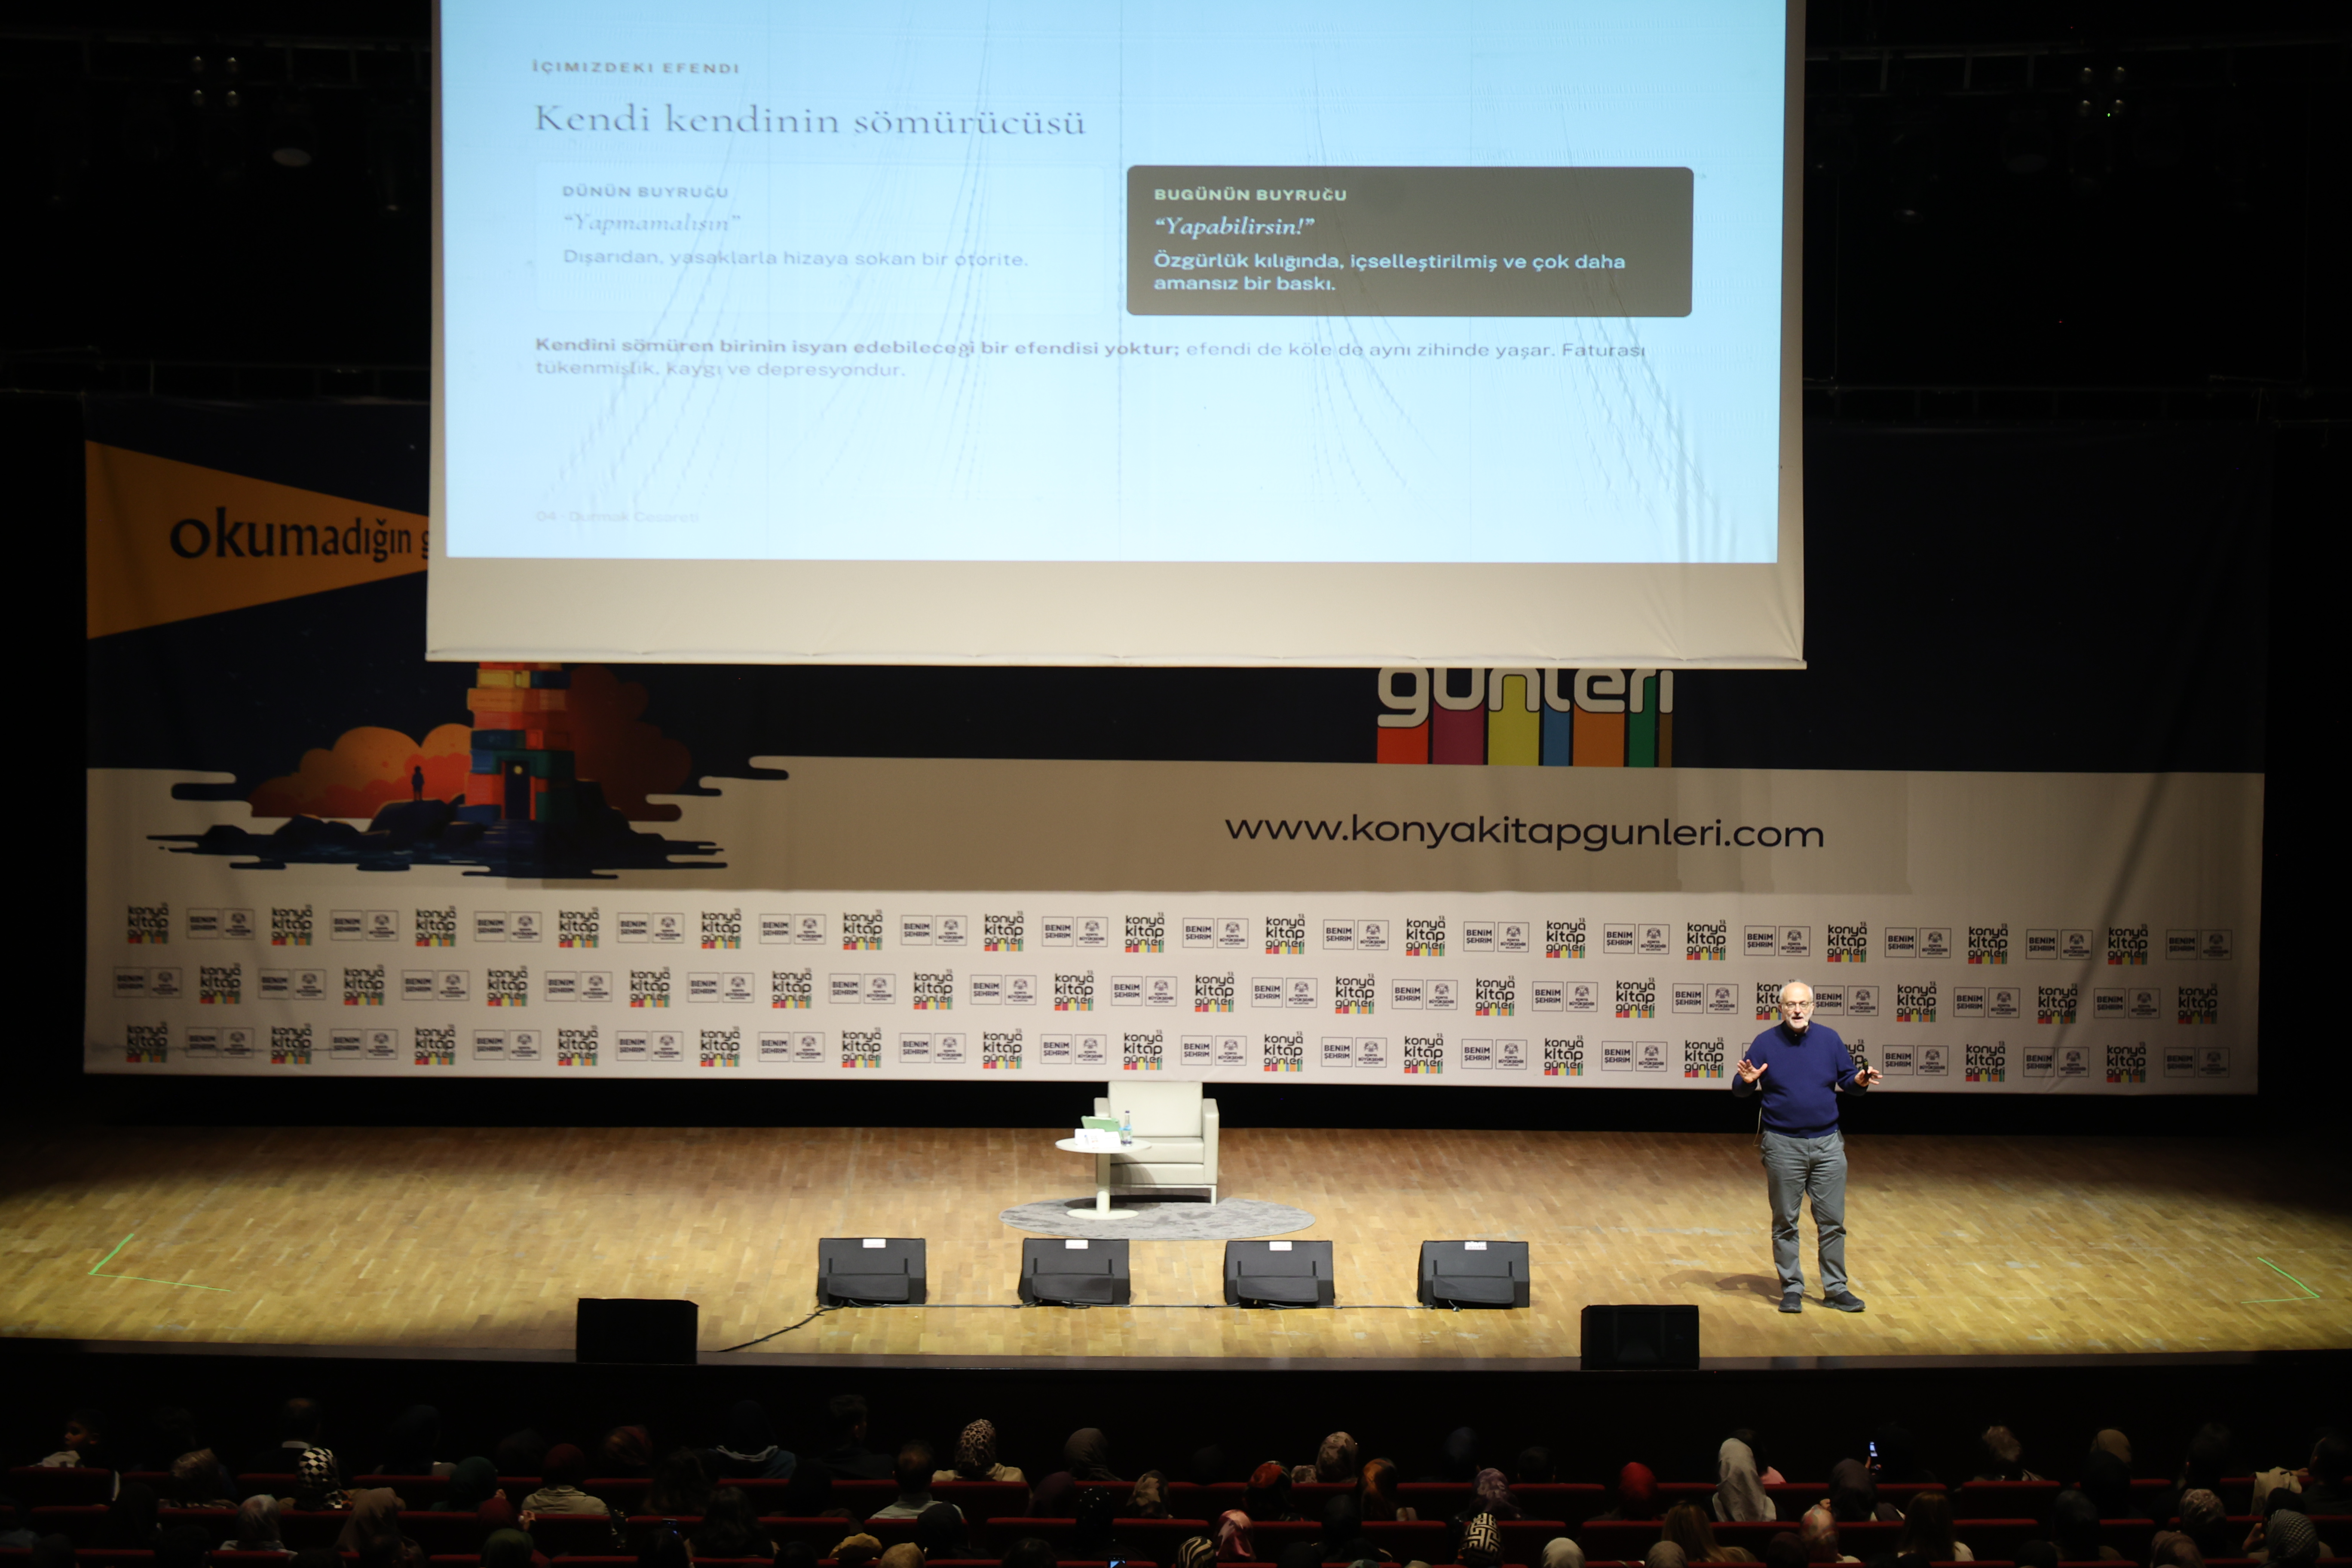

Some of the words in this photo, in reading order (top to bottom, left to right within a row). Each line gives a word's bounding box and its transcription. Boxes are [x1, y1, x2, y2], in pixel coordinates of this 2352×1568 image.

[534, 102, 649, 132] Kendi
[664, 103, 841, 134] kendinin
[854, 110, 1086, 135] sömürücüsü
[563, 184, 631, 197] DÜNÜN
[638, 185, 729, 198] BUYRUĞU
[1154, 187, 1250, 201] BUGÜNÜN
[1256, 187, 1347, 201] BUYRUĞU
[564, 249, 665, 266] Dışarıdan,
[670, 250, 778, 266] yasaklarla
[784, 251, 848, 267] hizaya
[855, 252, 915, 266] sokan
[923, 252, 948, 266] bir
[955, 253, 1028, 266] otorite.
[1153, 249, 1249, 270] Özgürlük
[1254, 253, 1344, 272] kılığında,
[1351, 254, 1498, 272] içselleştirilmiş
[1503, 257, 1527, 269] ve
[1532, 254, 1570, 272] çok
[1574, 255, 1626, 269] daha
[1154, 278, 1238, 290] amansız
[1244, 276, 1271, 290] bir
[1276, 276, 1336, 291] baskı.
[536, 338, 616, 352] Kendini
[622, 339, 714, 353] sömüren
[720, 339, 786, 353] birinin
[793, 340, 846, 355] isyan
[854, 340, 974, 358] edebileceği
[982, 341, 1008, 354] bir
[1015, 341, 1098, 355] efendisi
[1104, 342, 1179, 357] yoktur;
[1187, 342, 1251, 356] efendi
[1258, 343, 1282, 356] de
[1289, 343, 1332, 356] köle
[1339, 343, 1363, 356] de
[1370, 345, 1411, 359] aynı
[1417, 343, 1489, 357] zihinde
[1496, 346, 1556, 359] yaşar.
[1562, 343, 1645, 356] Faturası
[536, 361, 659, 378] tükenmişlik,
[667, 362, 721, 378] kaygı
[729, 364, 750, 376] ve
[757, 363, 905, 378] depresyondur.
[170, 506, 412, 563] okumadığın
[1224, 814, 1824, 852] www.konyakitapgunleri.com
[985, 913, 1024, 926] konya
[1126, 914, 1165, 927] konya
[1266, 916, 1305, 928] konya
[1406, 918, 1446, 931] konya
[1547, 920, 1586, 933] konya
[985, 923, 1023, 938] kitap
[1126, 925, 1164, 939] kitap
[1266, 926, 1305, 940] kitap
[1687, 922, 1726, 934] konya
[1828, 924, 1867, 937] konya
[1969, 925, 2008, 938] konya
[1406, 928, 1445, 943] kitap
[1547, 930, 1585, 945] kitap
[1687, 932, 1726, 946] kitap
[1828, 934, 1866, 949] kitap
[1969, 936, 2007, 950] kitap
[1055, 972, 1094, 985] konya
[1335, 975, 1375, 988] konya
[1476, 977, 1515, 990] konya
[1055, 983, 1093, 997] kitap
[1335, 986, 1374, 1000] kitap
[1616, 980, 1655, 992] konya
[1897, 983, 1936, 996] konya
[2178, 986, 2217, 998] konya
[1476, 988, 1515, 1002] kitap
[1616, 990, 1655, 1004] kitap
[1897, 994, 1936, 1008] kitap
[2178, 996, 2217, 1011] kitap
[842, 1029, 882, 1042] konya
[1404, 1035, 1443, 1048] konya
[842, 1040, 881, 1054] kitap
[1544, 1037, 1583, 1050] konya
[1685, 1039, 1724, 1052] konya
[1966, 1043, 2005, 1056] konya
[1404, 1045, 1443, 1060] kitap
[1544, 1047, 1583, 1062] kitap
[1685, 1050, 1724, 1064] kitap
[1966, 1054, 2005, 1068] kitap
